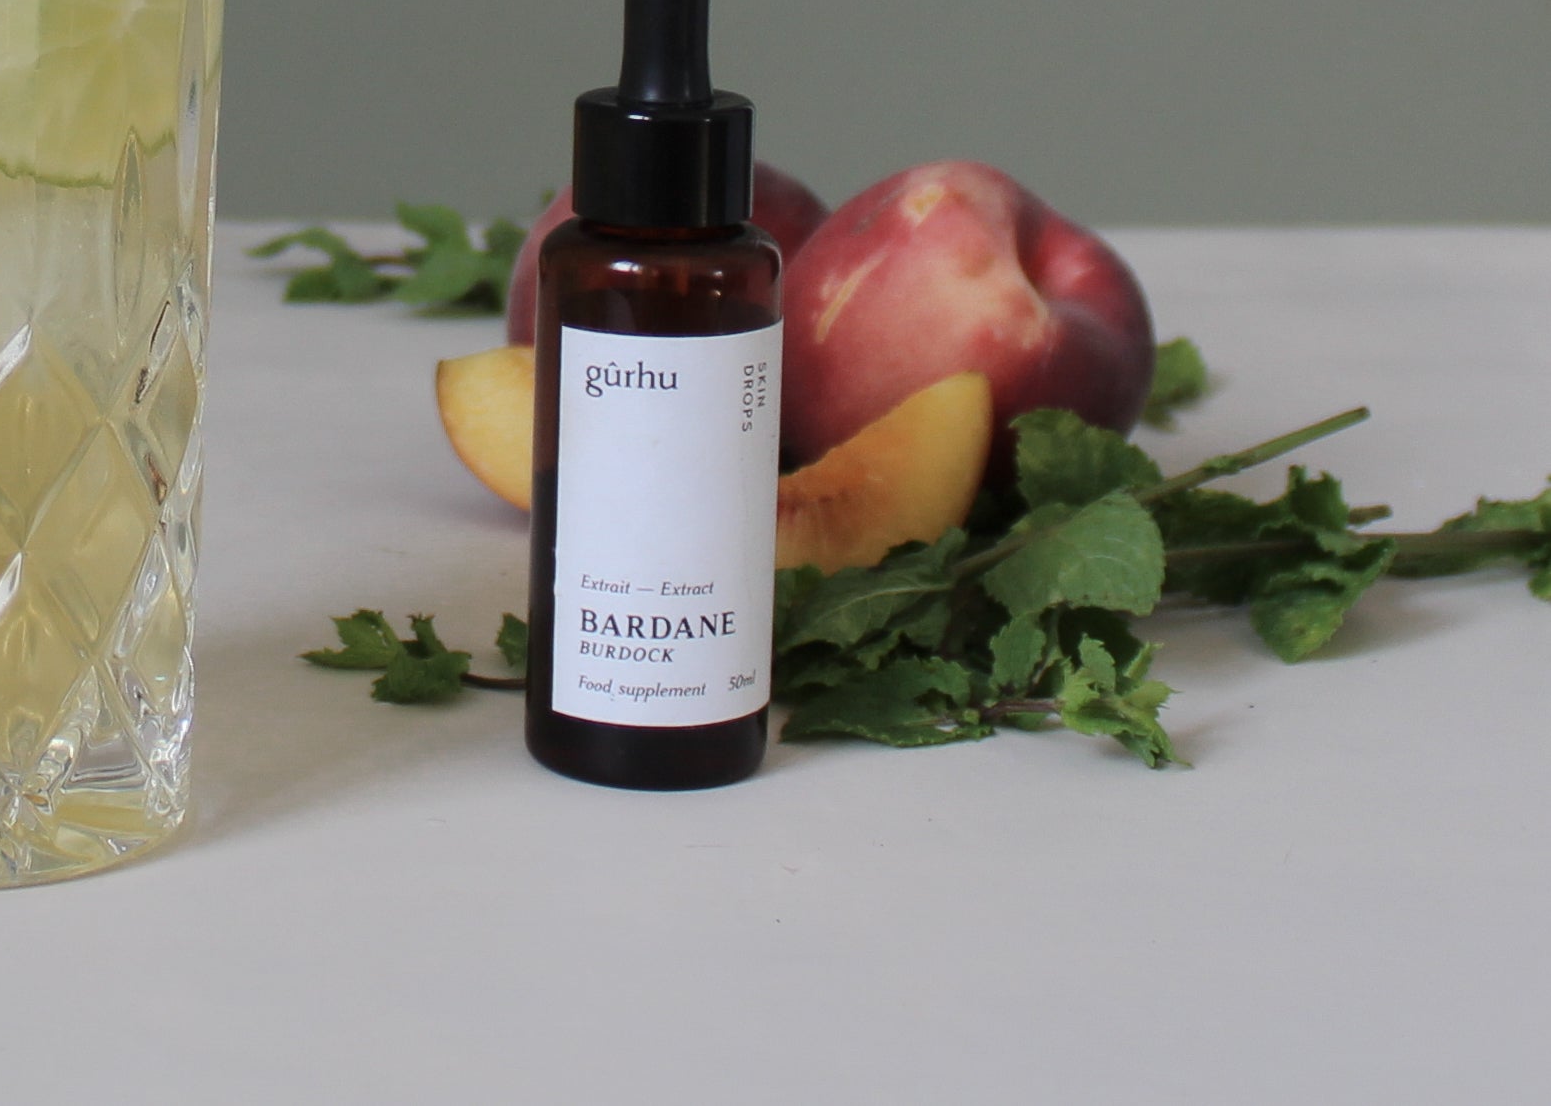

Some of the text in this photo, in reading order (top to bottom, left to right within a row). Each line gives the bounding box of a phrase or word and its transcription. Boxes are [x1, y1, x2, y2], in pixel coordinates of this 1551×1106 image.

[585, 360, 678, 398] gûrhu
[757, 361, 767, 408] SKIN
[741, 364, 754, 433] DROPS
[580, 573, 631, 595] Extrait
[660, 580, 715, 596] Extract
[580, 608, 736, 640] BARDANE
[579, 640, 675, 663] BURDOCK
[578, 674, 707, 703] Food supplement
[727, 668, 757, 691] 50ml
